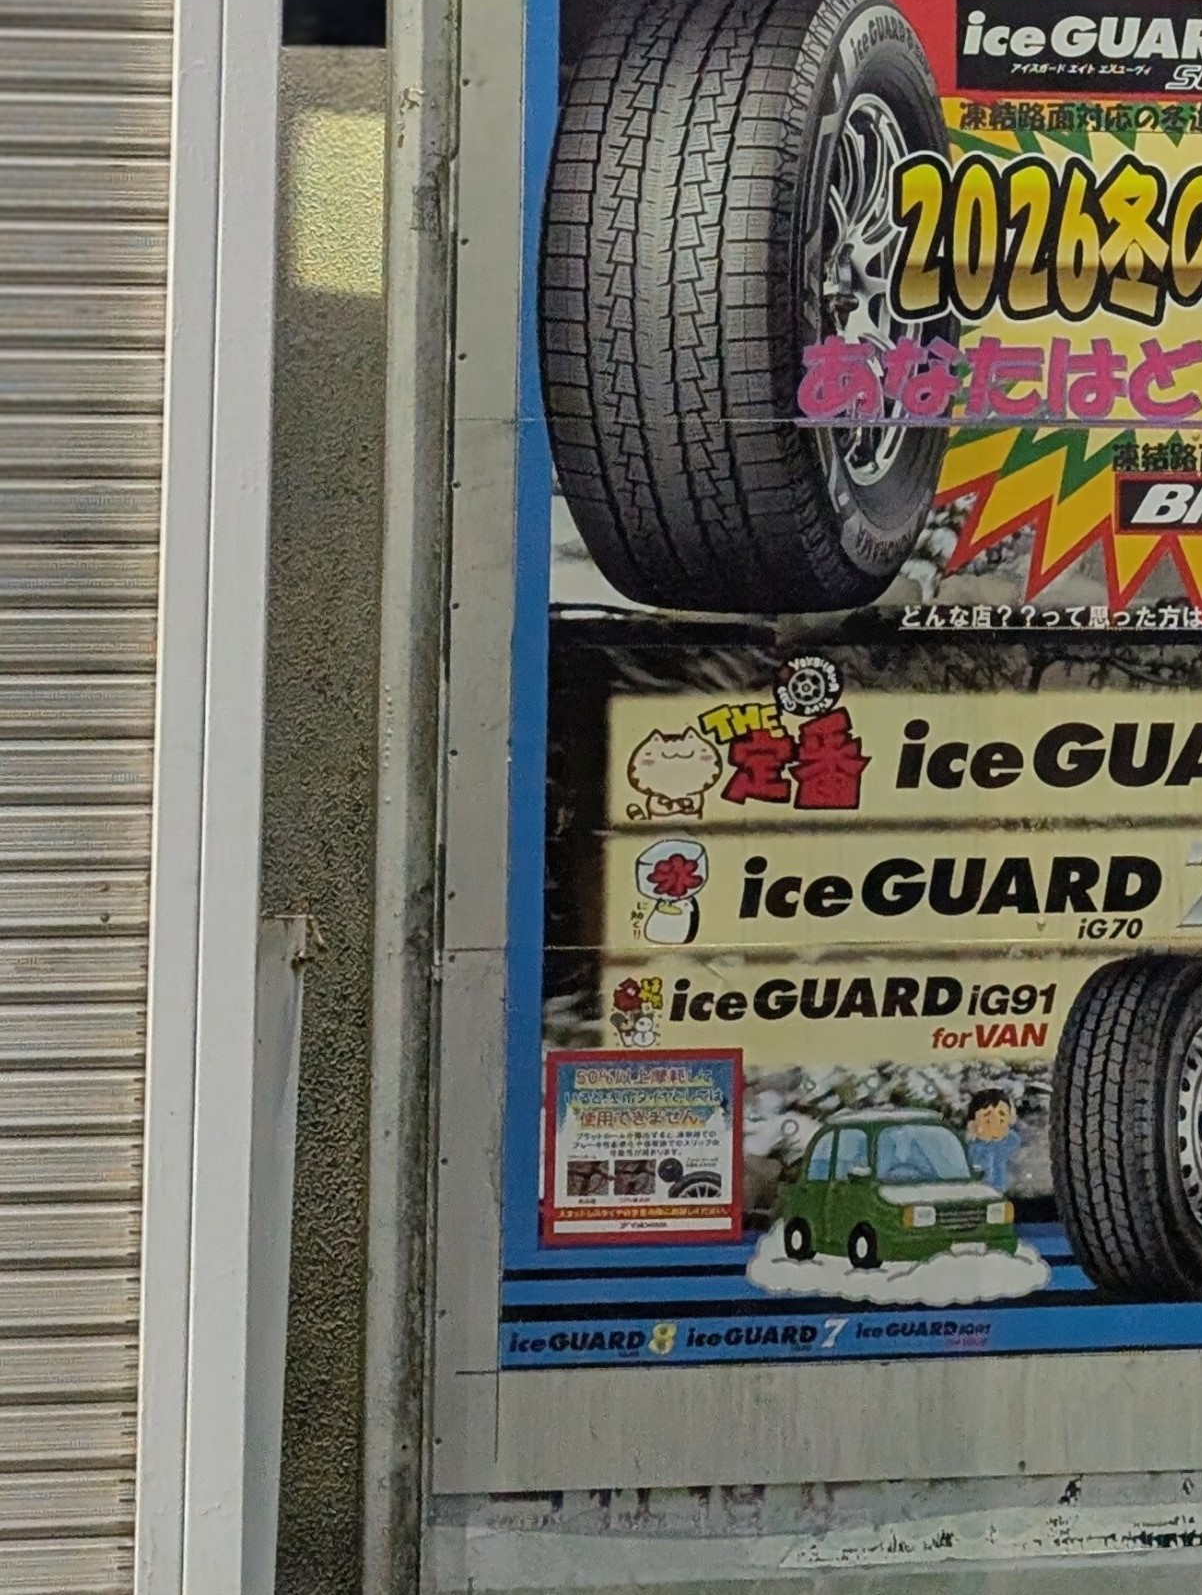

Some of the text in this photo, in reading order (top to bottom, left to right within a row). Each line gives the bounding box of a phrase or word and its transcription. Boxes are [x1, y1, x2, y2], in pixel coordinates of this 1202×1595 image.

[722, 708, 870, 808] 定番
[739, 855, 1162, 919] iceGUARD
[1077, 917, 1143, 940] iG70
[669, 977, 962, 1021] iceGUARD
[969, 983, 1056, 1015] iG91
[932, 1023, 1049, 1050] for VAN
[509, 1323, 677, 1355] iceGUARD 8
[687, 1318, 850, 1348] iceGUARD 7
